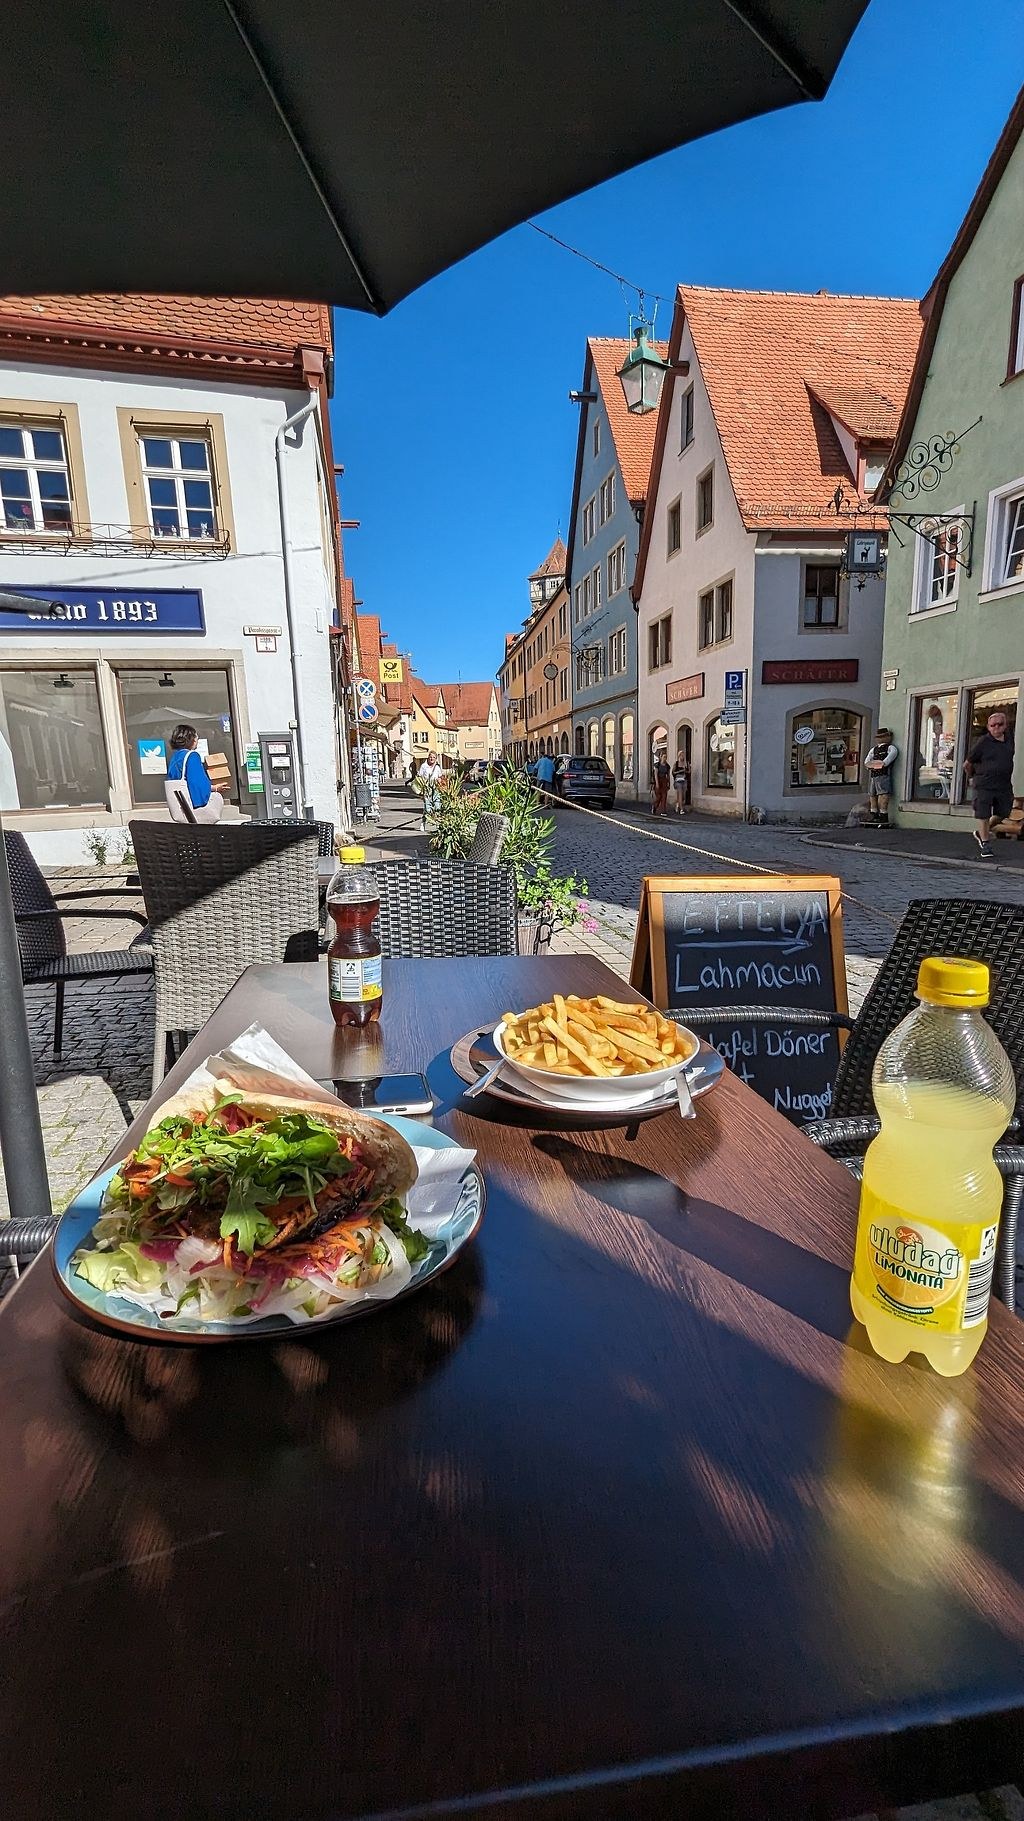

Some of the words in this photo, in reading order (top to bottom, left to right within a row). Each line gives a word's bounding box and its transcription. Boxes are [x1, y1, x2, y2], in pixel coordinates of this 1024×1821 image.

[28, 603, 87, 621] no
[97, 600, 158, 622] 1893
[729, 673, 739, 689] P
[675, 953, 821, 993] Lahmacun
[764, 1029, 831, 1056] Döner
[870, 1223, 960, 1280] uludağ
